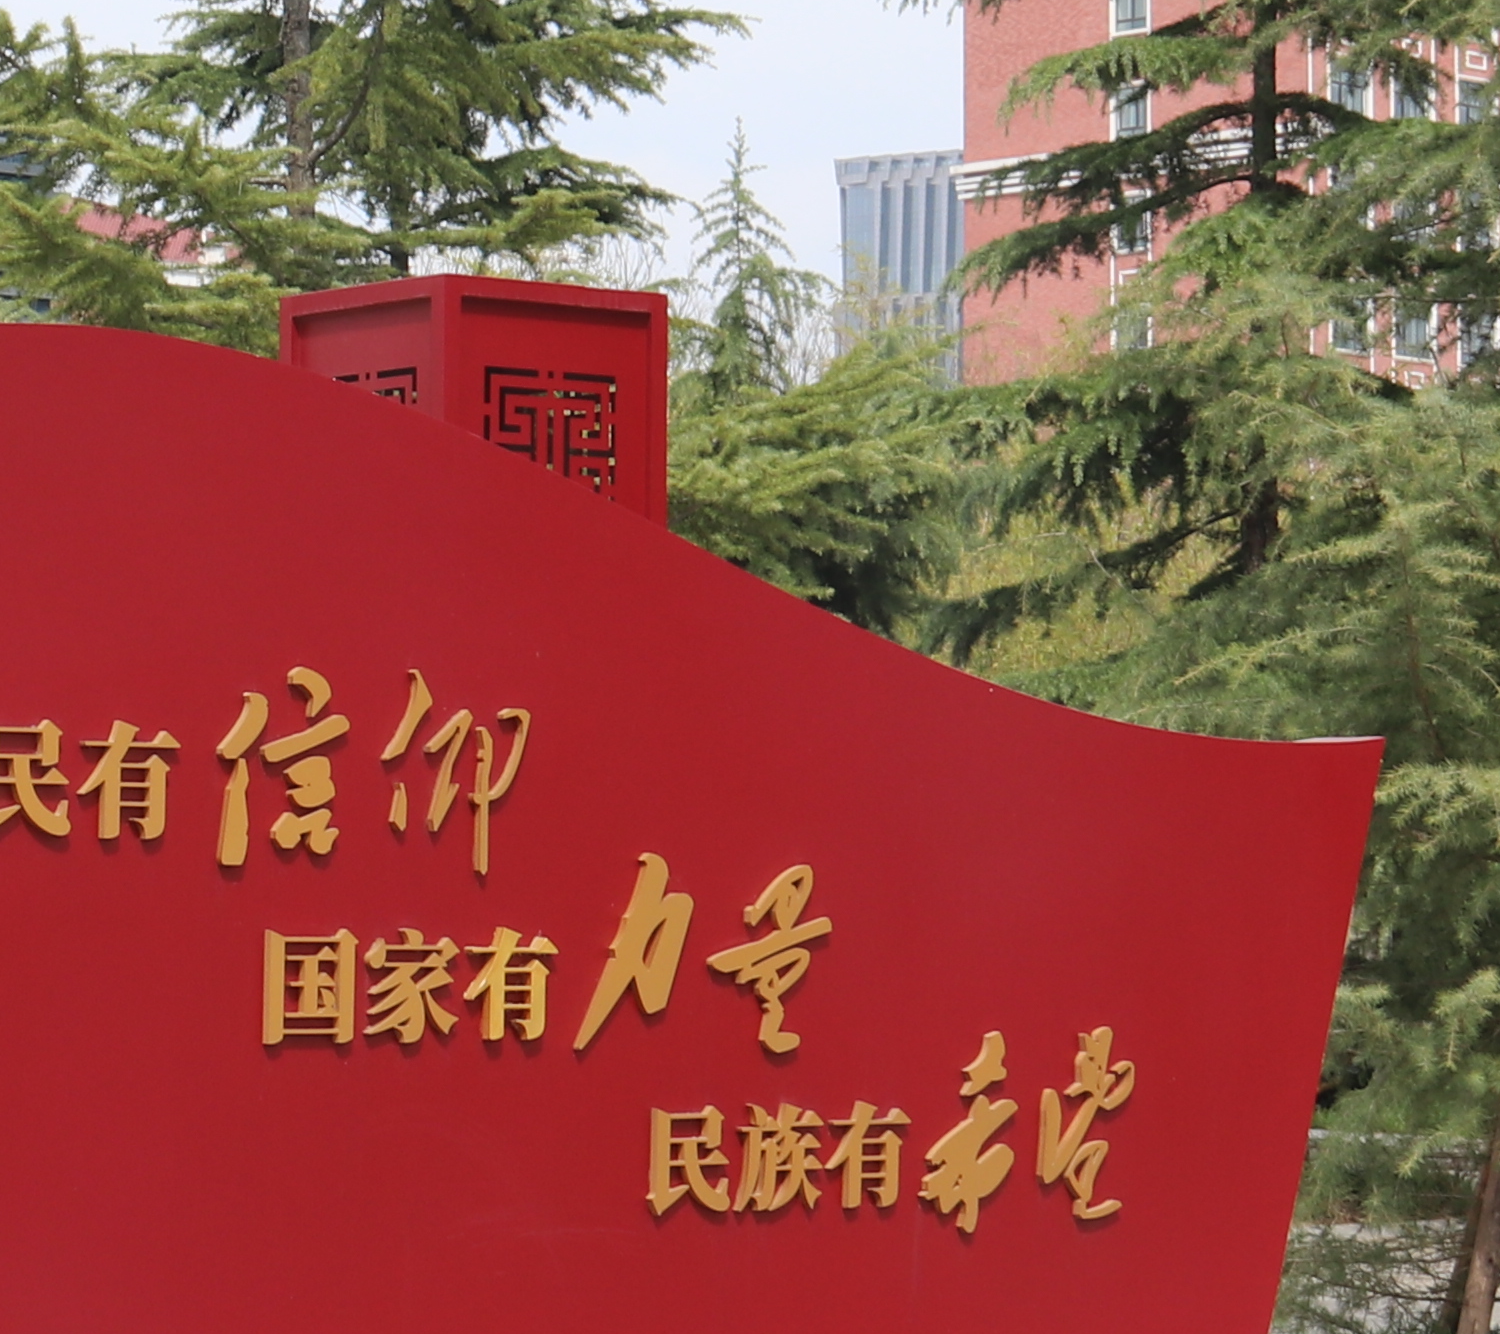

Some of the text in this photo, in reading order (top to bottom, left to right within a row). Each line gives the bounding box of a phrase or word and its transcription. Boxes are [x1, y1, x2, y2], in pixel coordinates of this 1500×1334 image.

[262, 852, 833, 1055] 国家有力量
[648, 1025, 1136, 1234] 民族有希望
